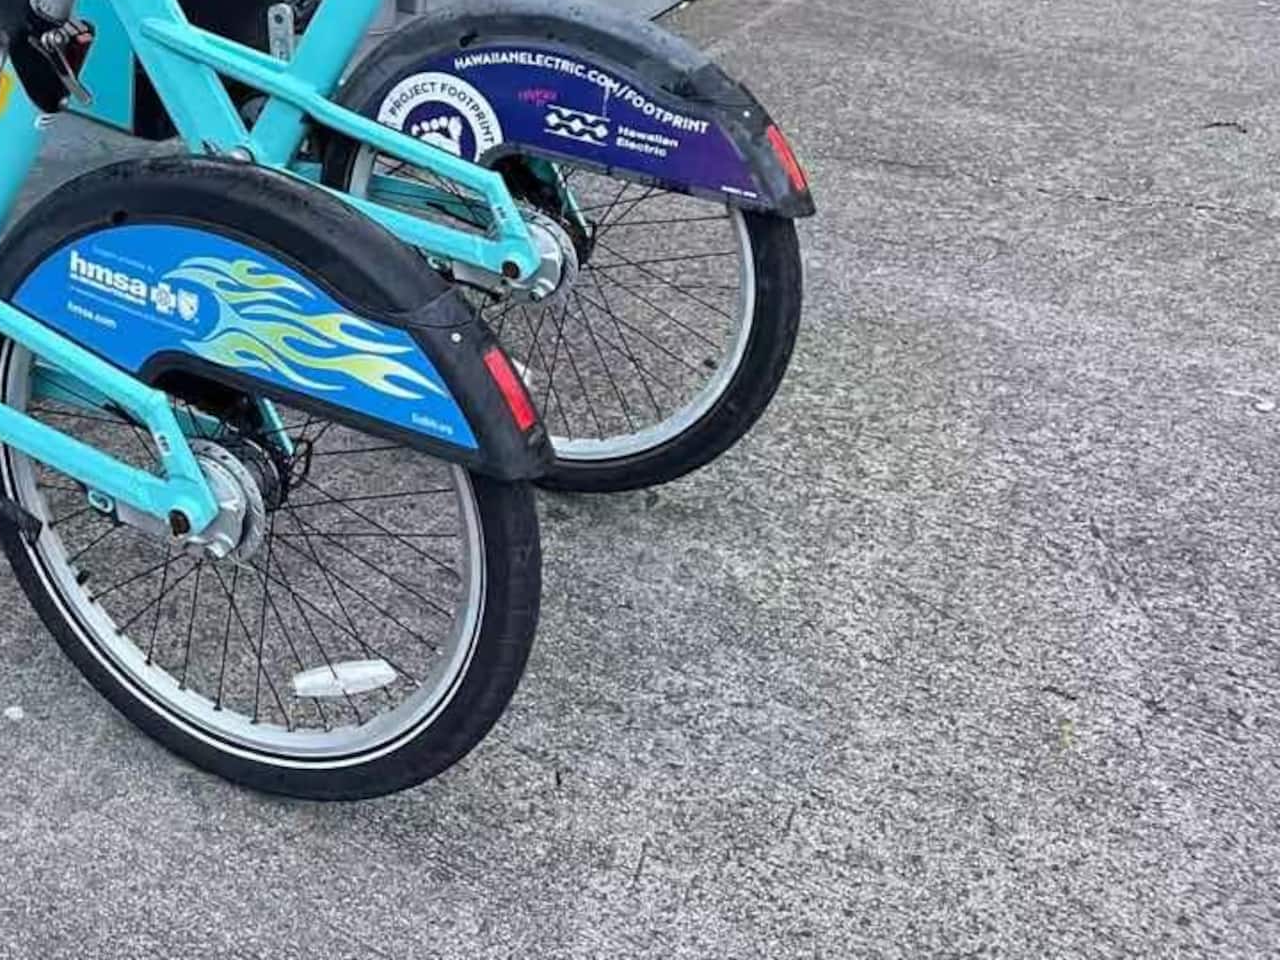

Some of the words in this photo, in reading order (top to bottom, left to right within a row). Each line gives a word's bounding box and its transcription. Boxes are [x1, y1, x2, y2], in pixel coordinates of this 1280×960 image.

[389, 81, 438, 117] PROJECT
[440, 82, 495, 144] FOOTPRINT
[454, 51, 710, 134] HAWAIIANELECTRIC.COM/FOOTPRINT
[616, 137, 668, 158] Electric
[617, 125, 679, 148] Hawaiian
[70, 249, 148, 299] hmsa
